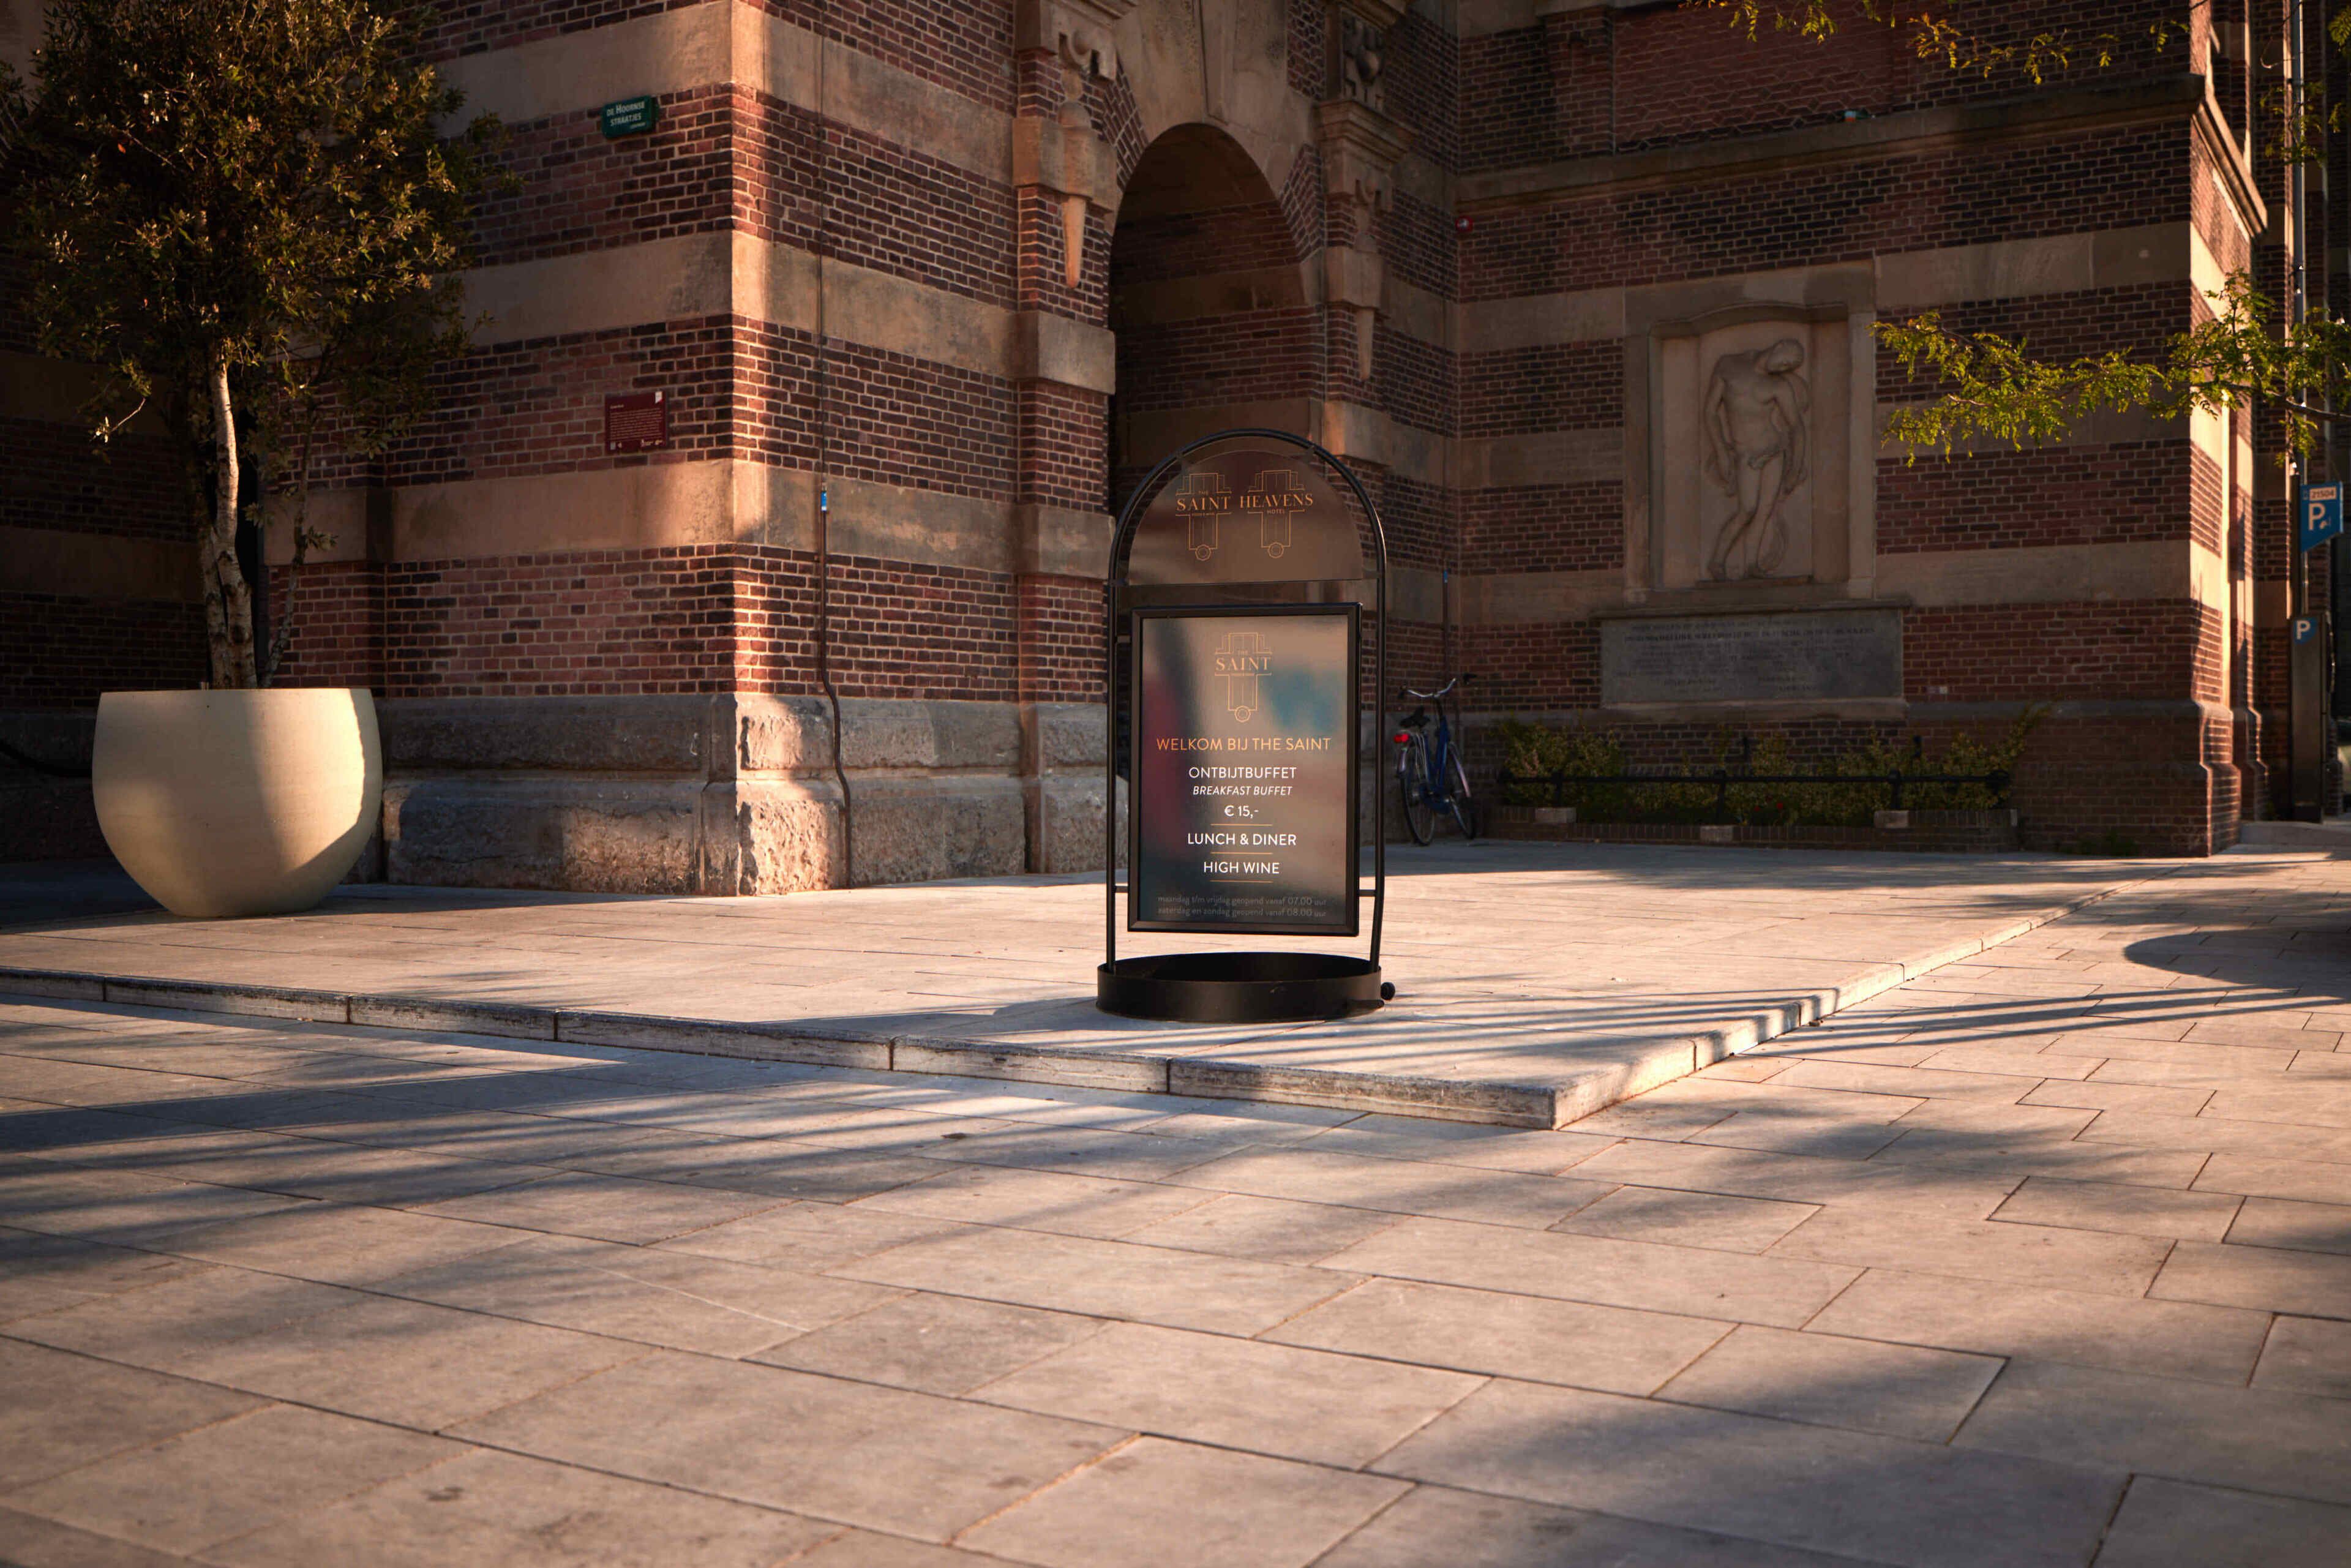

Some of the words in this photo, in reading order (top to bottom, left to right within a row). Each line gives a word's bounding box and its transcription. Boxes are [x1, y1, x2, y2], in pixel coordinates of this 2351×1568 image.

[1176, 495, 1231, 511] SAINT
[1239, 492, 1314, 509] HEAVENS
[2308, 503, 2326, 530] P
[2297, 620, 2311, 640] P
[1215, 656, 1272, 671] SAINT
[1157, 738, 1223, 751] WELKOM
[1228, 738, 1248, 751] BIJ
[1252, 737, 1282, 751] THE
[1285, 737, 1332, 751] SAINT
[1188, 767, 1297, 779] ONTBIJTBUFFET
[1193, 786, 1251, 796] BREAKFAST
[1253, 786, 1294, 796] BUFFET
[1224, 805, 1235, 817] €
[1238, 805, 1259, 819] 15,-
[1187, 833, 1236, 846] LUNCH
[1239, 833, 1249, 846] &
[1253, 834, 1297, 846] DINER
[1204, 861, 1239, 874] HIGH
[1243, 862, 1280, 874] WINE
[1287, 896, 1313, 906] 07.00
[1287, 908, 1313, 917] 08.00
